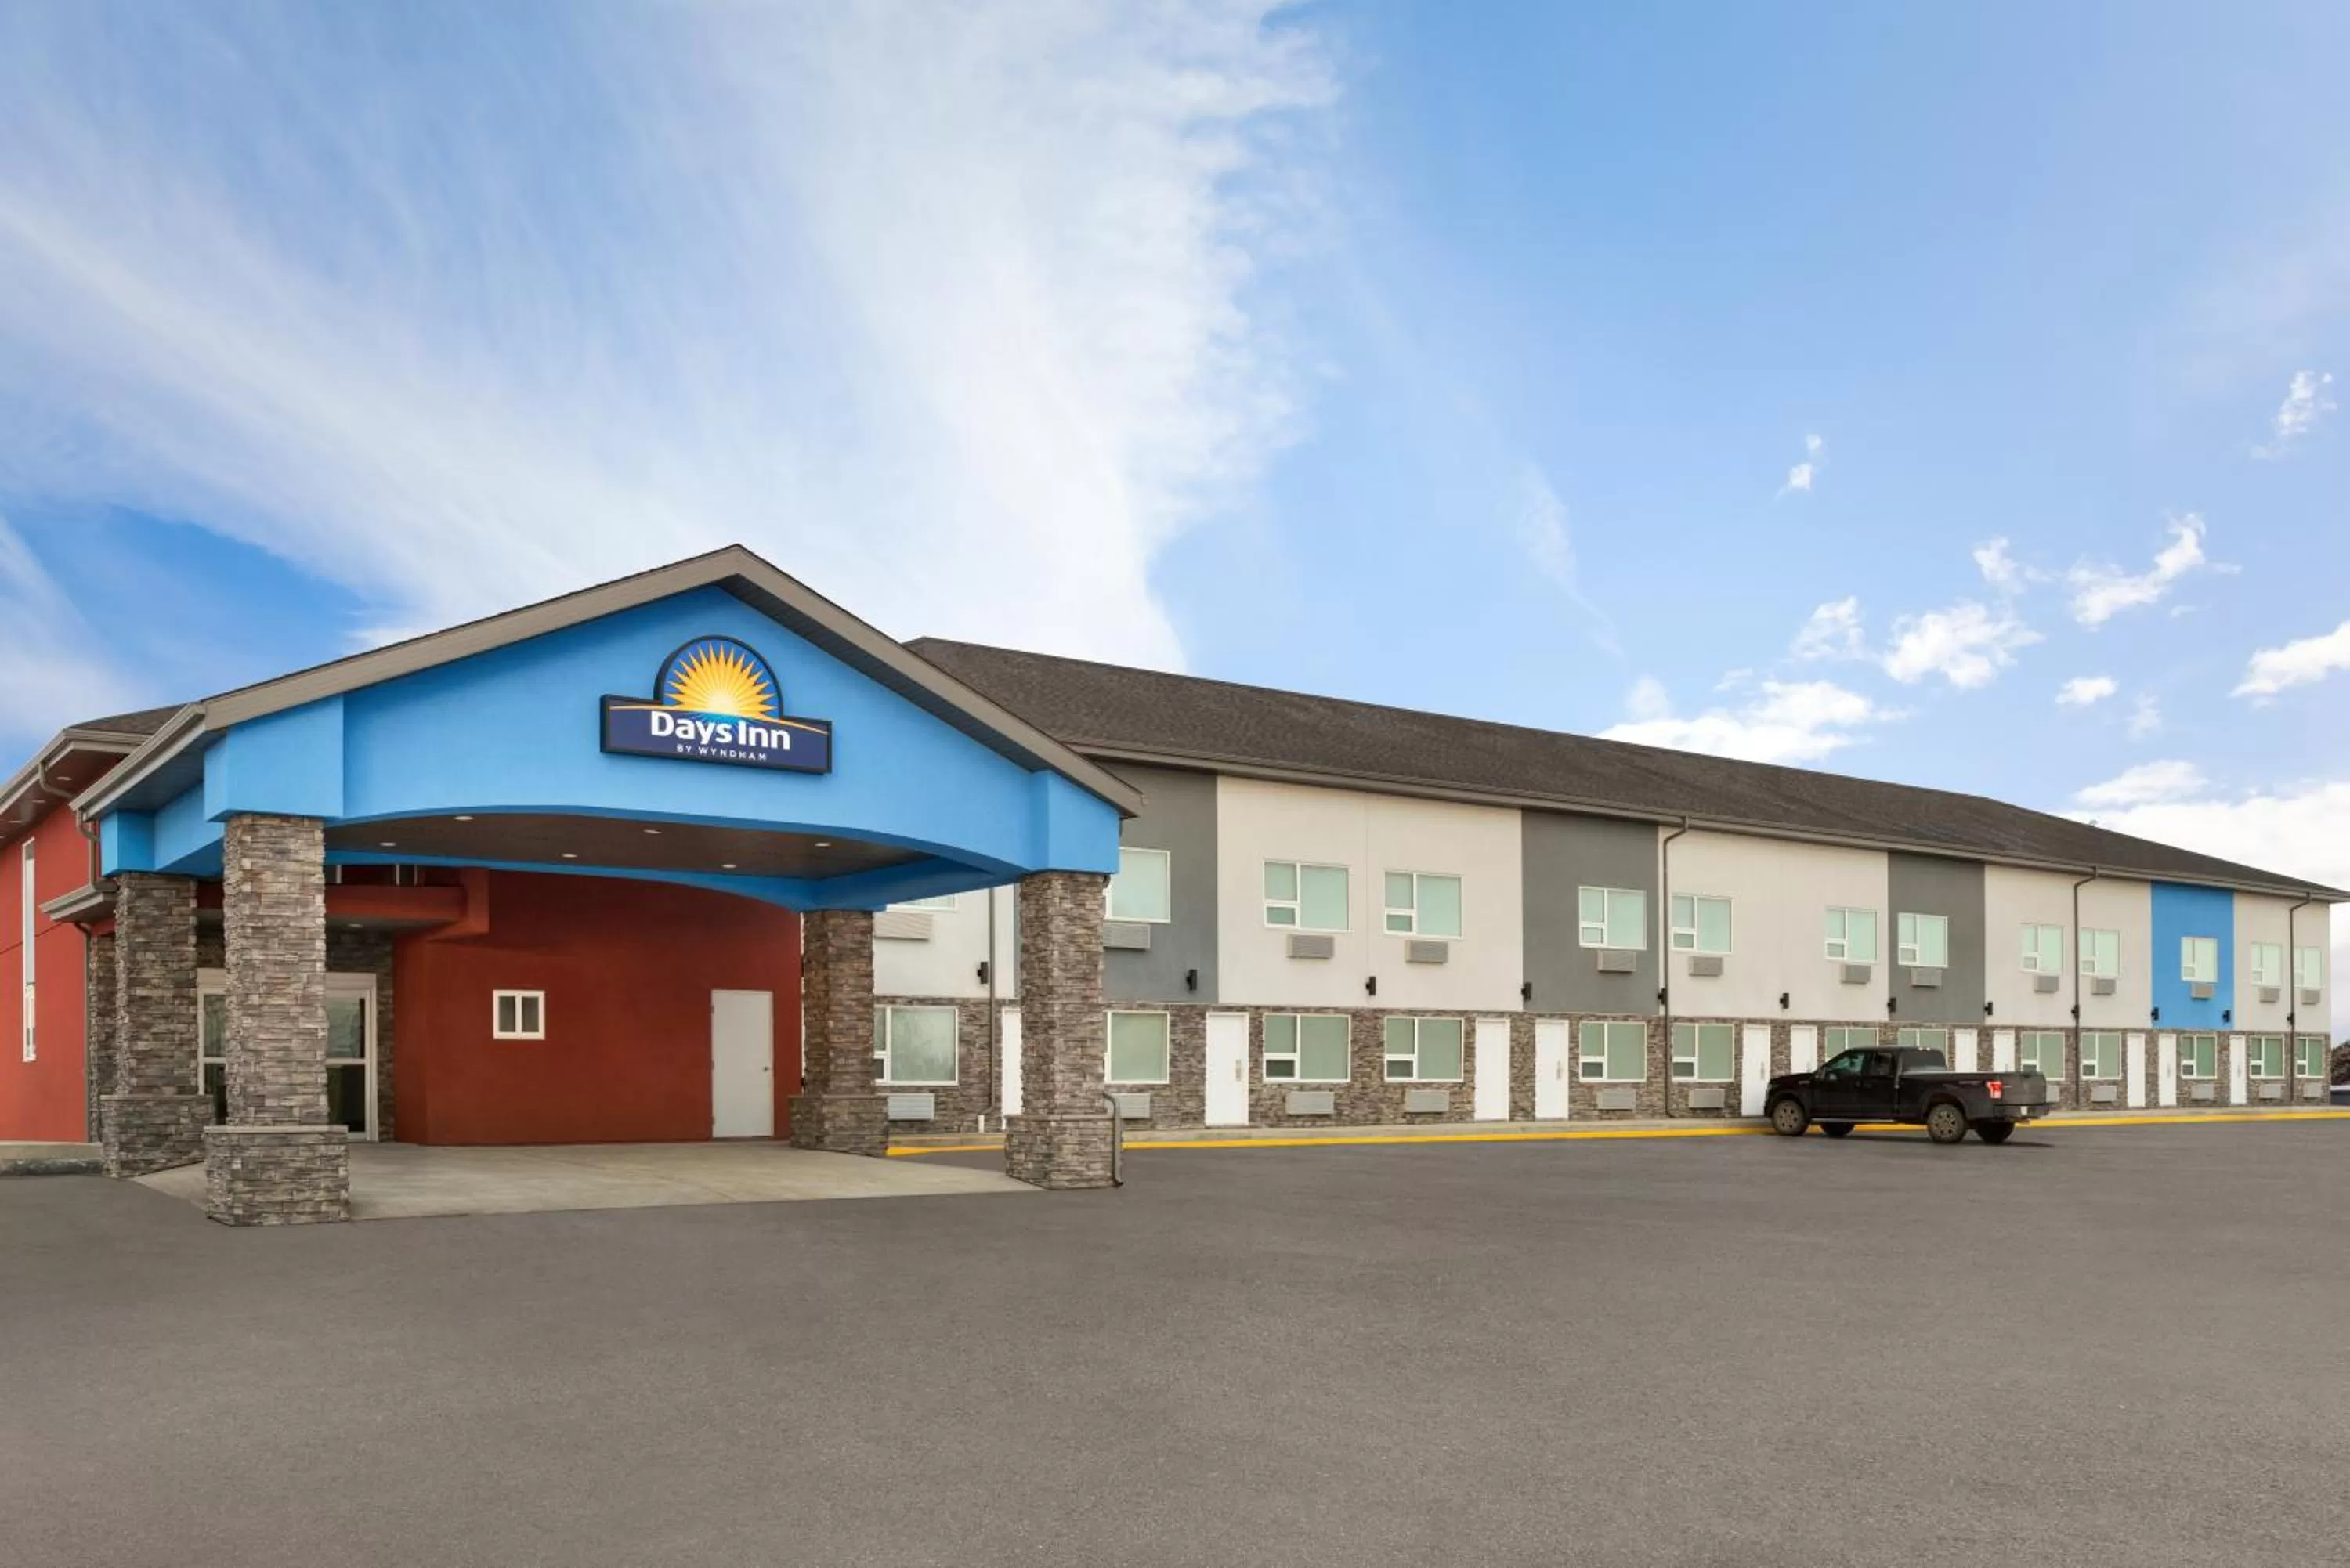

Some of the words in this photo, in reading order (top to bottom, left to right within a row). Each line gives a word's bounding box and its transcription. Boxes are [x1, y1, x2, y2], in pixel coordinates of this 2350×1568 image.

[650, 710, 732, 745] Days
[738, 721, 790, 750] Inn
[676, 744, 692, 753] BY
[698, 746, 767, 761] WYNDHAM
